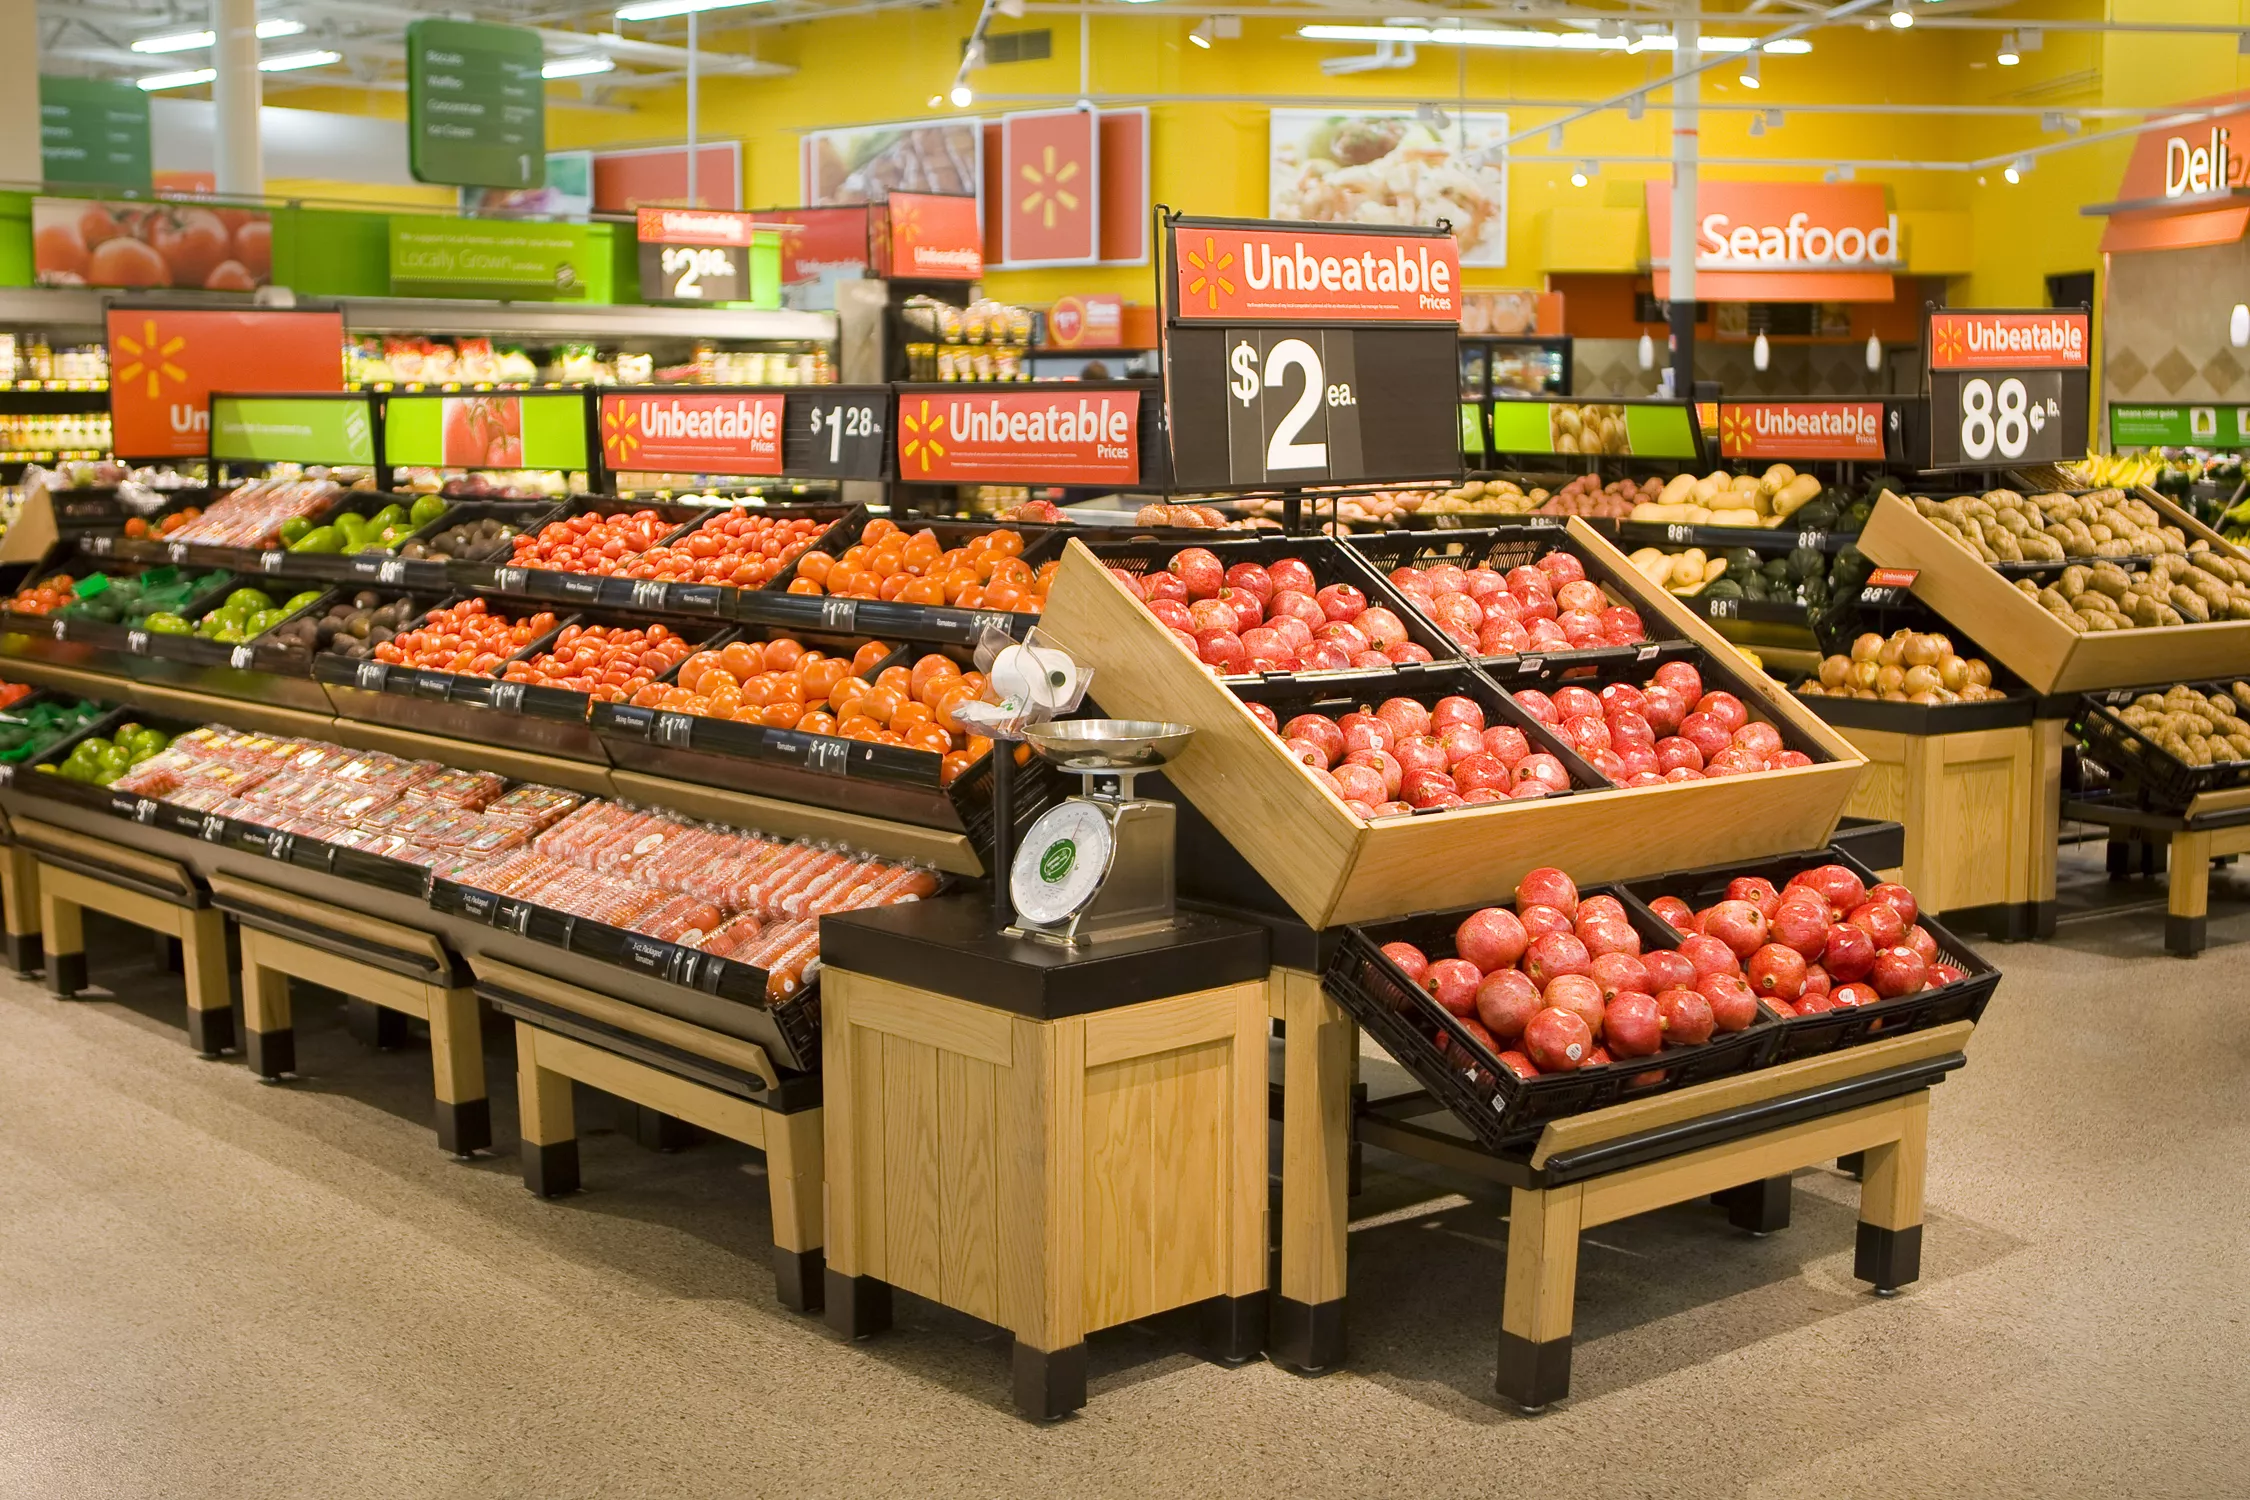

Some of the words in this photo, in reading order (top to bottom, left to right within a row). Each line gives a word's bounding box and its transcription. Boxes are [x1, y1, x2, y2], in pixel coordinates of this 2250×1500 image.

[518, 154, 531, 184] 1
[2166, 127, 2228, 198] Deli
[1702, 212, 1898, 264] Seafood
[1243, 242, 1450, 293] Unbeatable
[1419, 293, 1451, 311] Prices
[1967, 319, 2082, 351] Unbeatable
[2063, 348, 2081, 361] Prices
[1327, 382, 1356, 407] ea.
[640, 400, 776, 439] Unbeatable
[950, 399, 1128, 443] Unbeatable
[1755, 406, 1876, 435] Unbeatable
[1890, 410, 1899, 431] $
[751, 439, 775, 452] Prices
[1855, 434, 1877, 445] Prices
[1098, 444, 1129, 459] Prices
[627, 716, 644, 726] Tomatoes
[776, 741, 796, 752] Tomatoes
[634, 953, 654, 966] Tomatoes
[642, 944, 663, 958] Packaged
